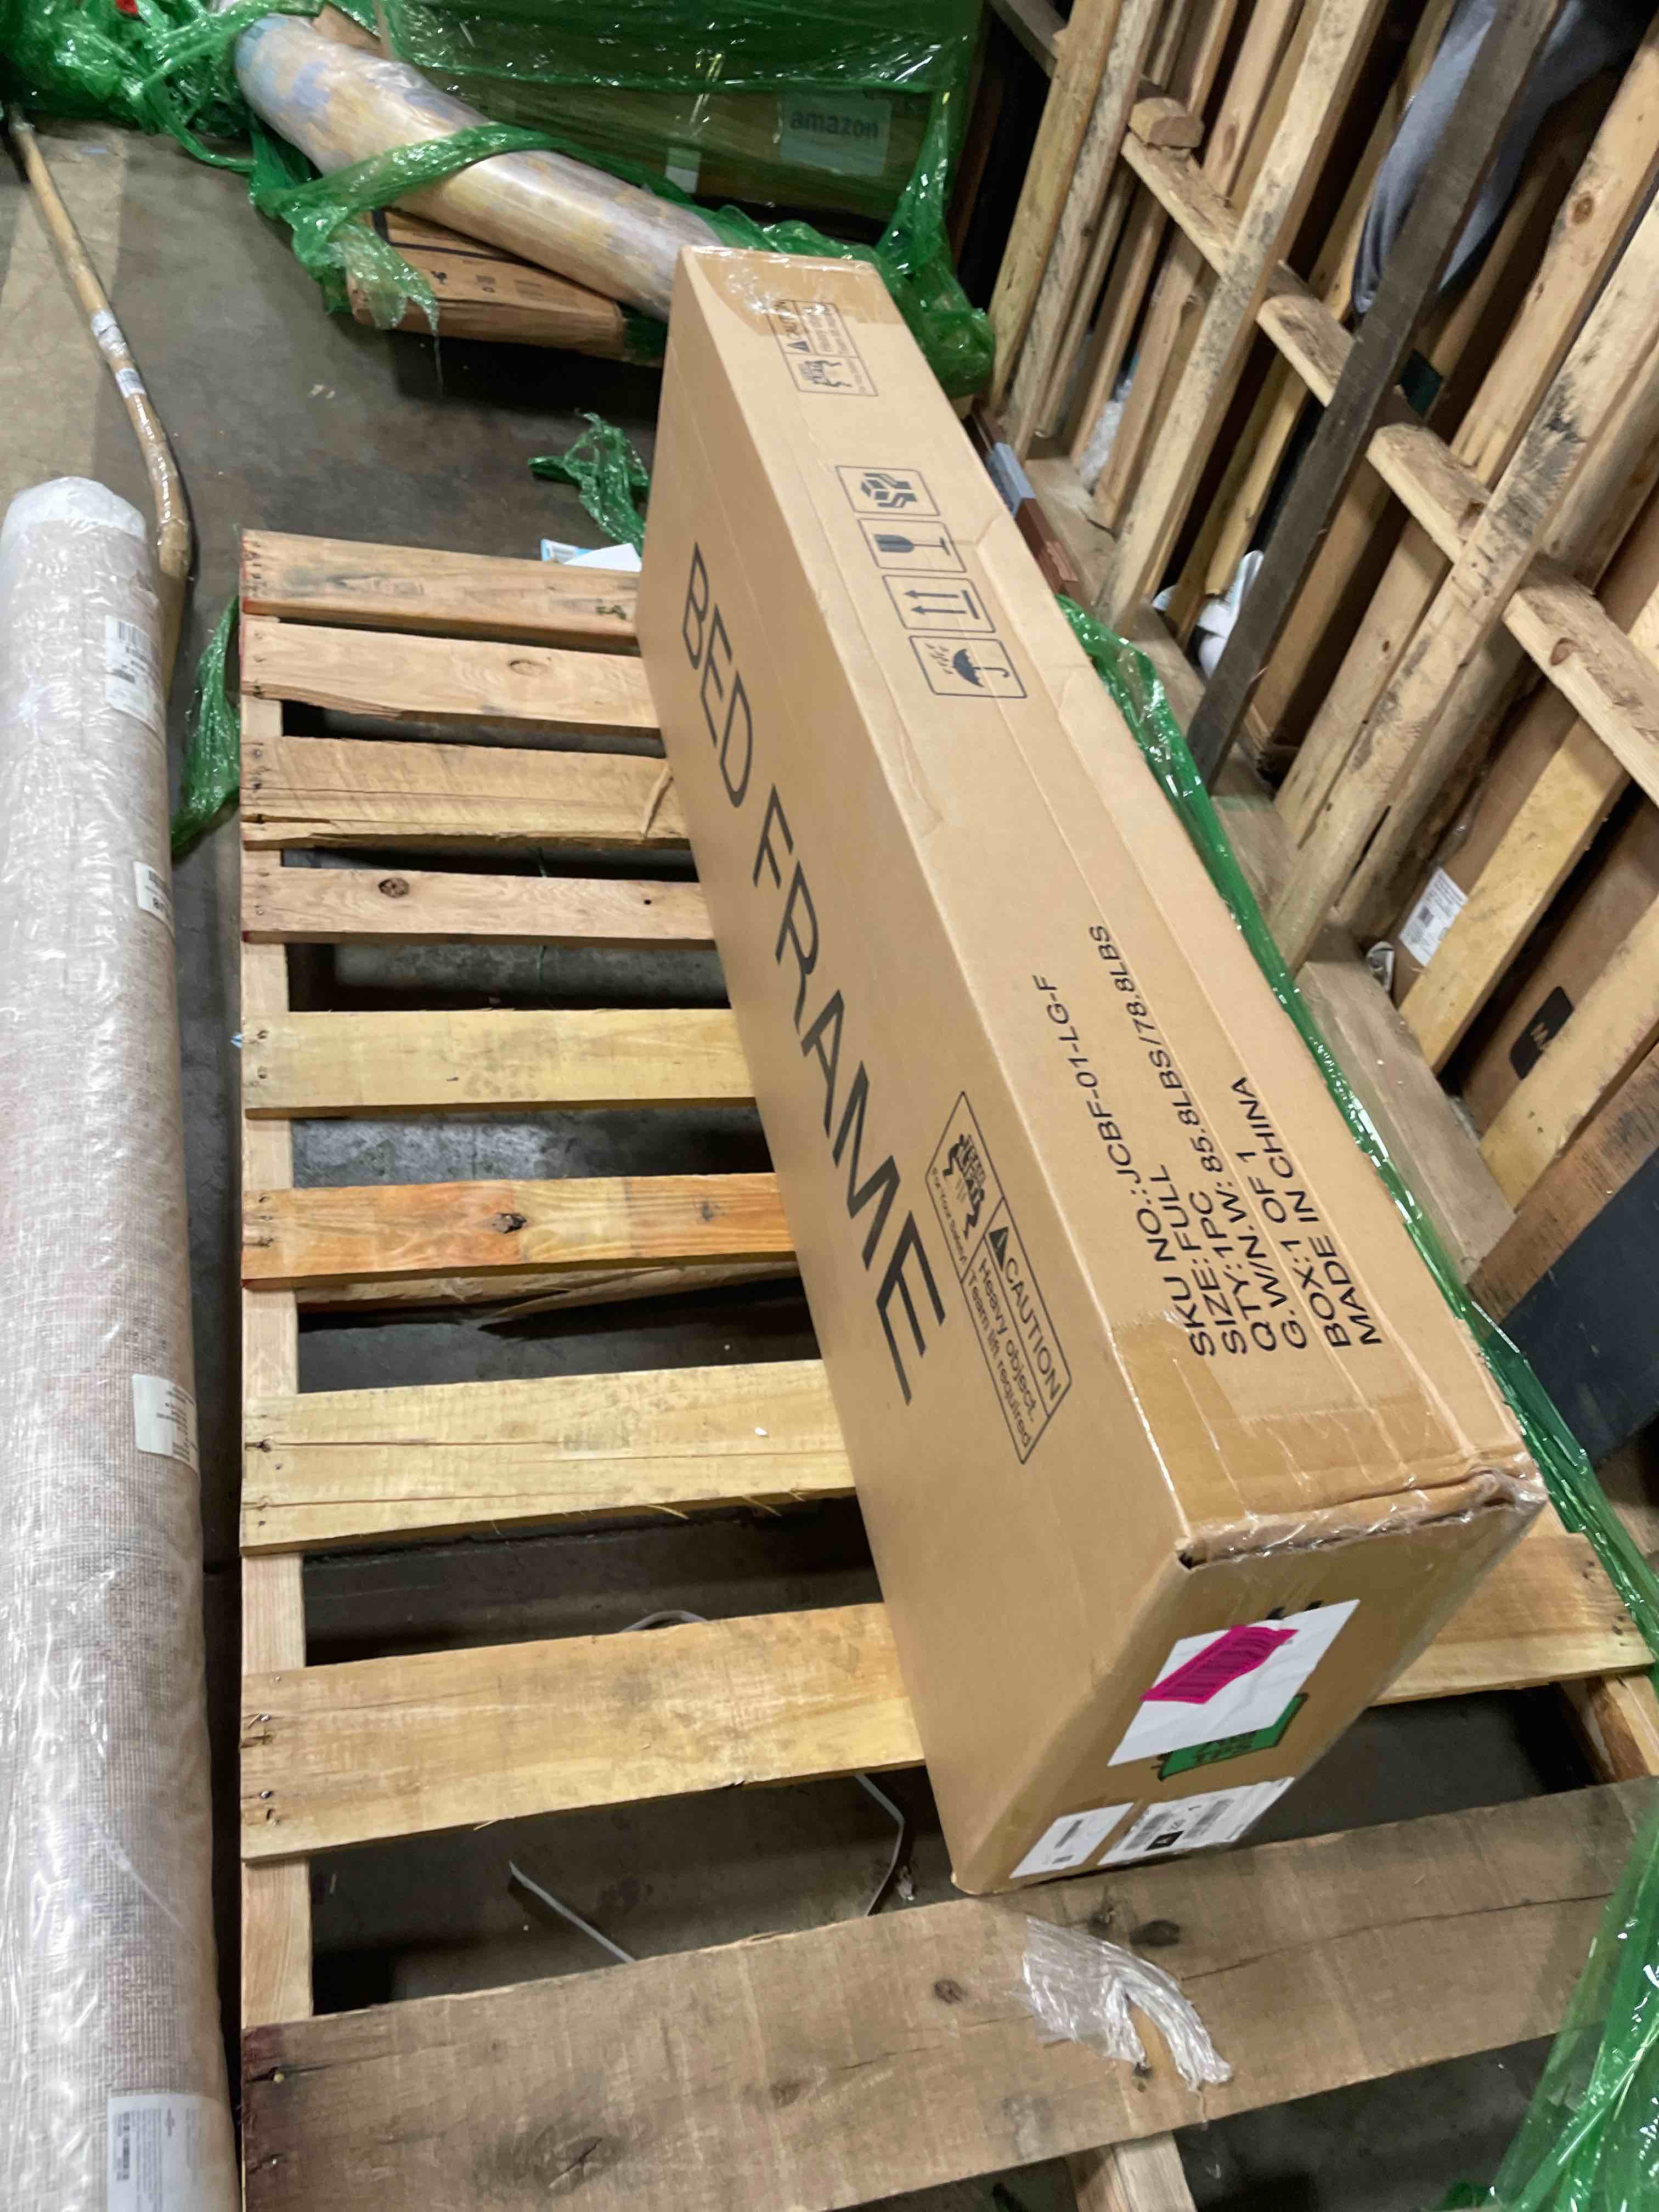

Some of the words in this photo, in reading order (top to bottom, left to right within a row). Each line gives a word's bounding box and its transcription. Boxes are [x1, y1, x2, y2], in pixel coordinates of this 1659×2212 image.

[789, 111, 879, 140] amazon
[682, 541, 753, 808] BED
[752, 783, 946, 1406] FRAME
[1231, 1076, 1294, 1179] CHINA
[1235, 1150, 1256, 1164] 1
[1247, 1176, 1286, 1223] OF
[1285, 1190, 1319, 1222] IN
[978, 1257, 1008, 1335] Heavy
[1188, 1190, 1277, 1352] QTY:1PC
[1307, 1234, 1383, 1345] MADE
[967, 1268, 989, 1332] Team
[987, 1327, 1002, 1358] lift
[997, 1357, 1031, 1448] required
[1005, 1257, 1062, 1401] CAUTION
[1163, 1277, 1215, 1357] SKU
